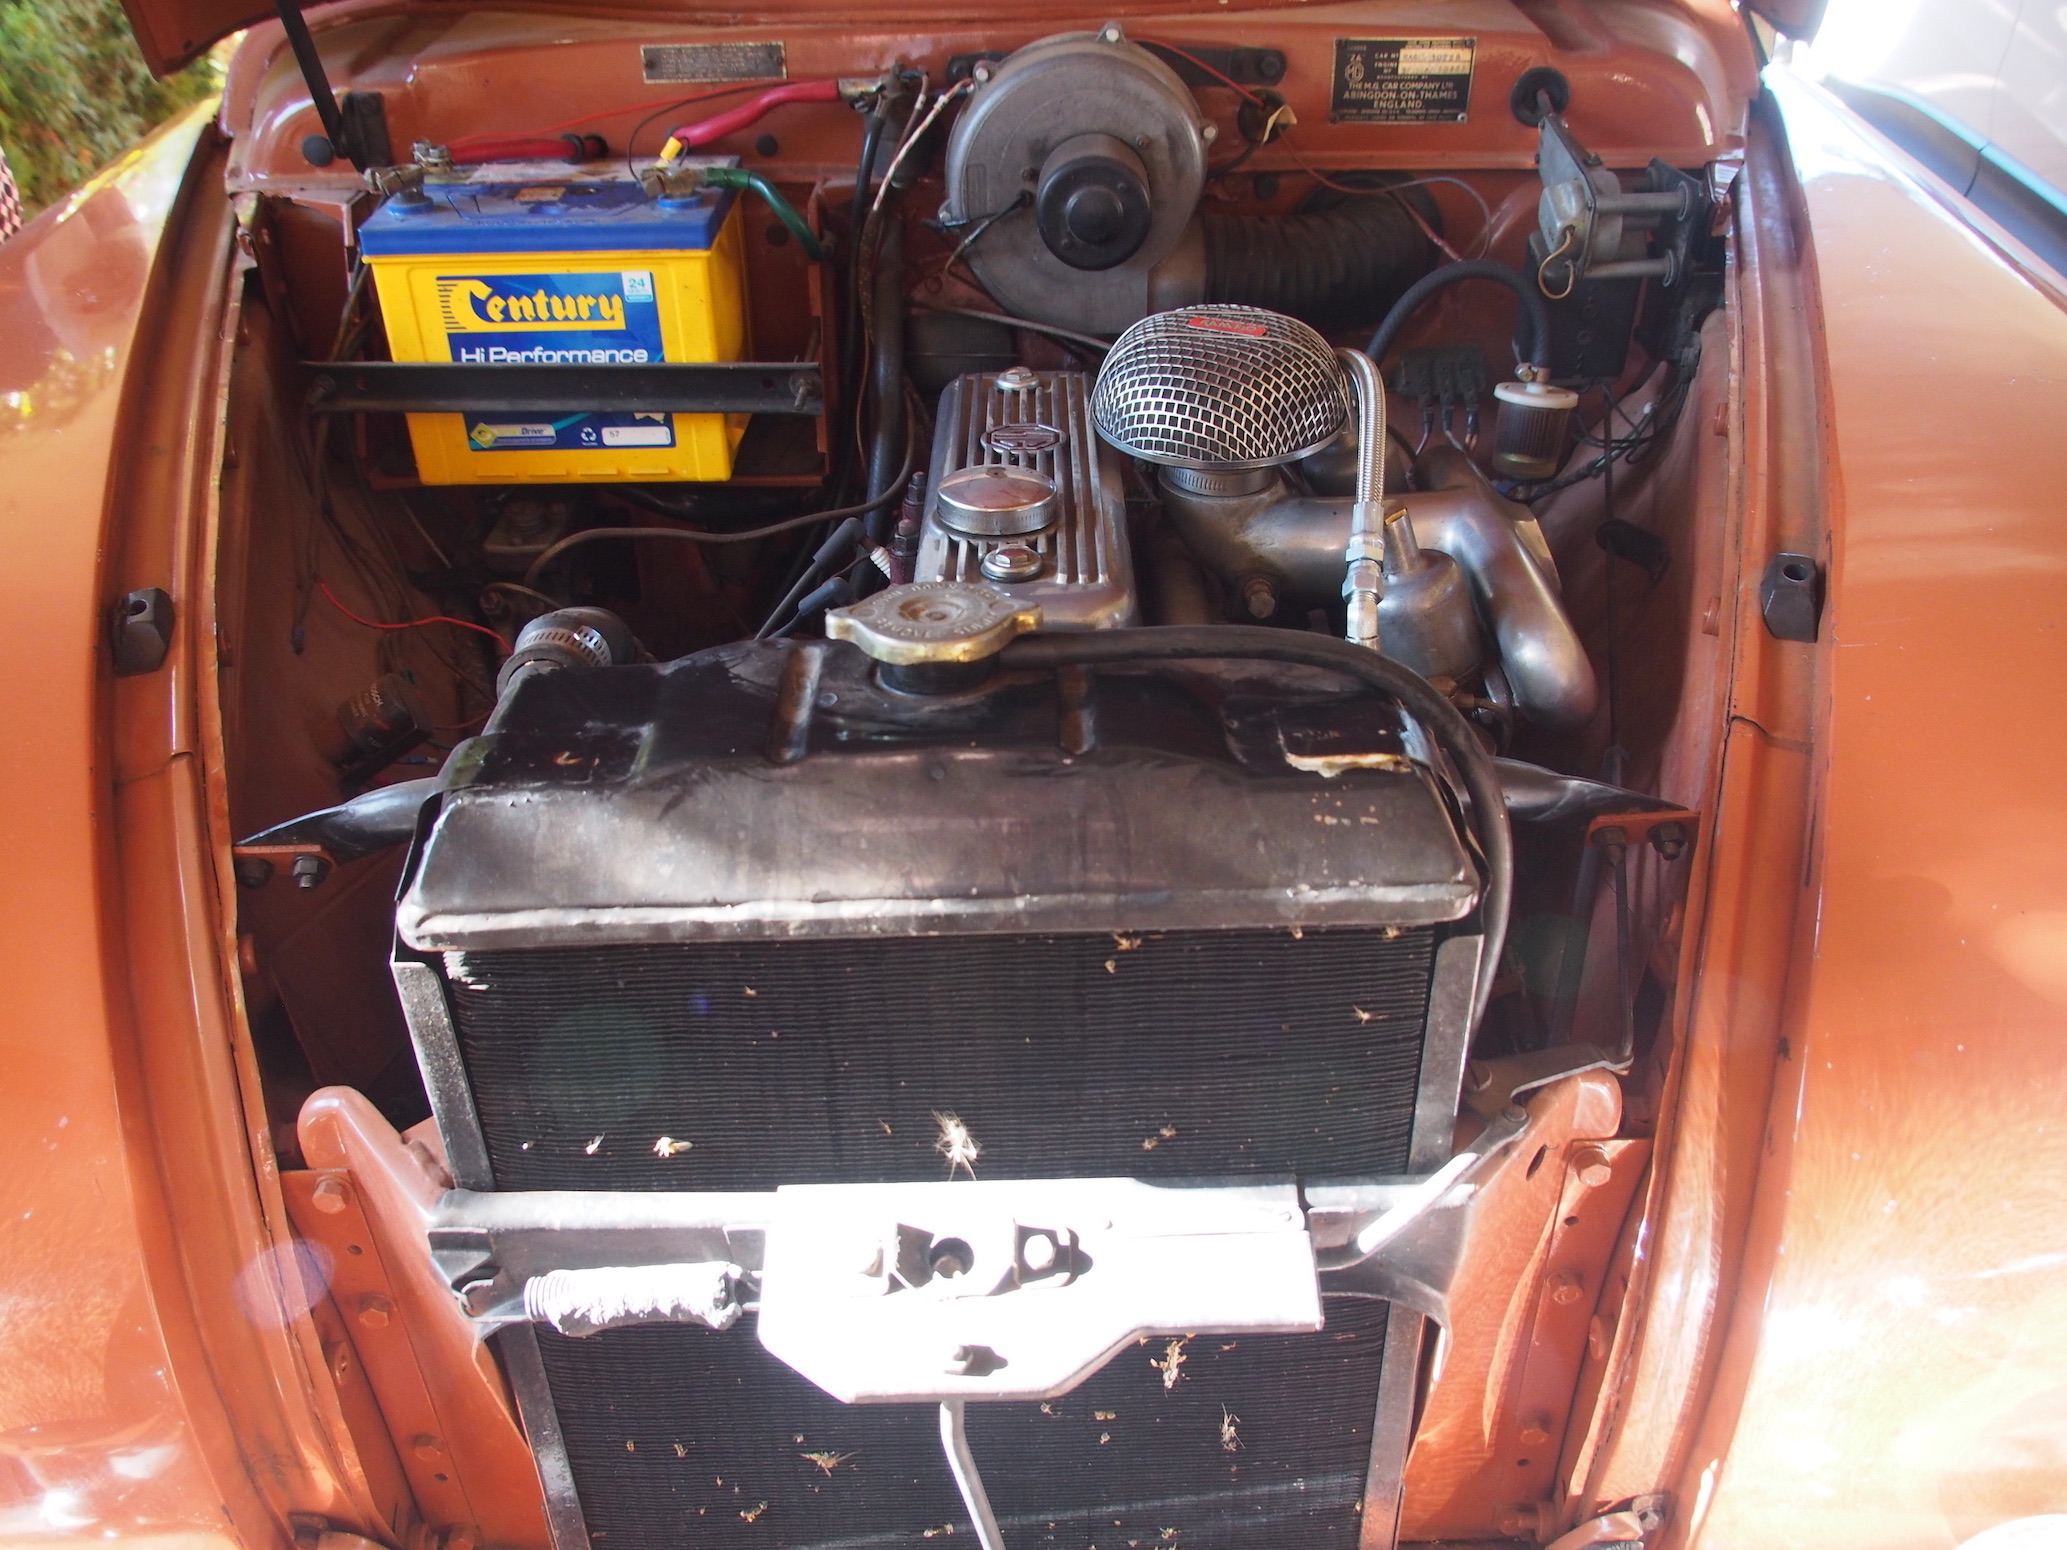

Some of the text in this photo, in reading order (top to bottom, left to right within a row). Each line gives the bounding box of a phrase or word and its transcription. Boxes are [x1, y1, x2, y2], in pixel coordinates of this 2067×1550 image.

[1348, 81, 1362, 90] THE
[1382, 81, 1399, 90] CAR
[1400, 81, 1441, 90] COMPANY
[628, 278, 645, 288] 24
[437, 279, 627, 333] Century
[460, 346, 648, 364] Hi Performance
[521, 427, 545, 436] Drive
